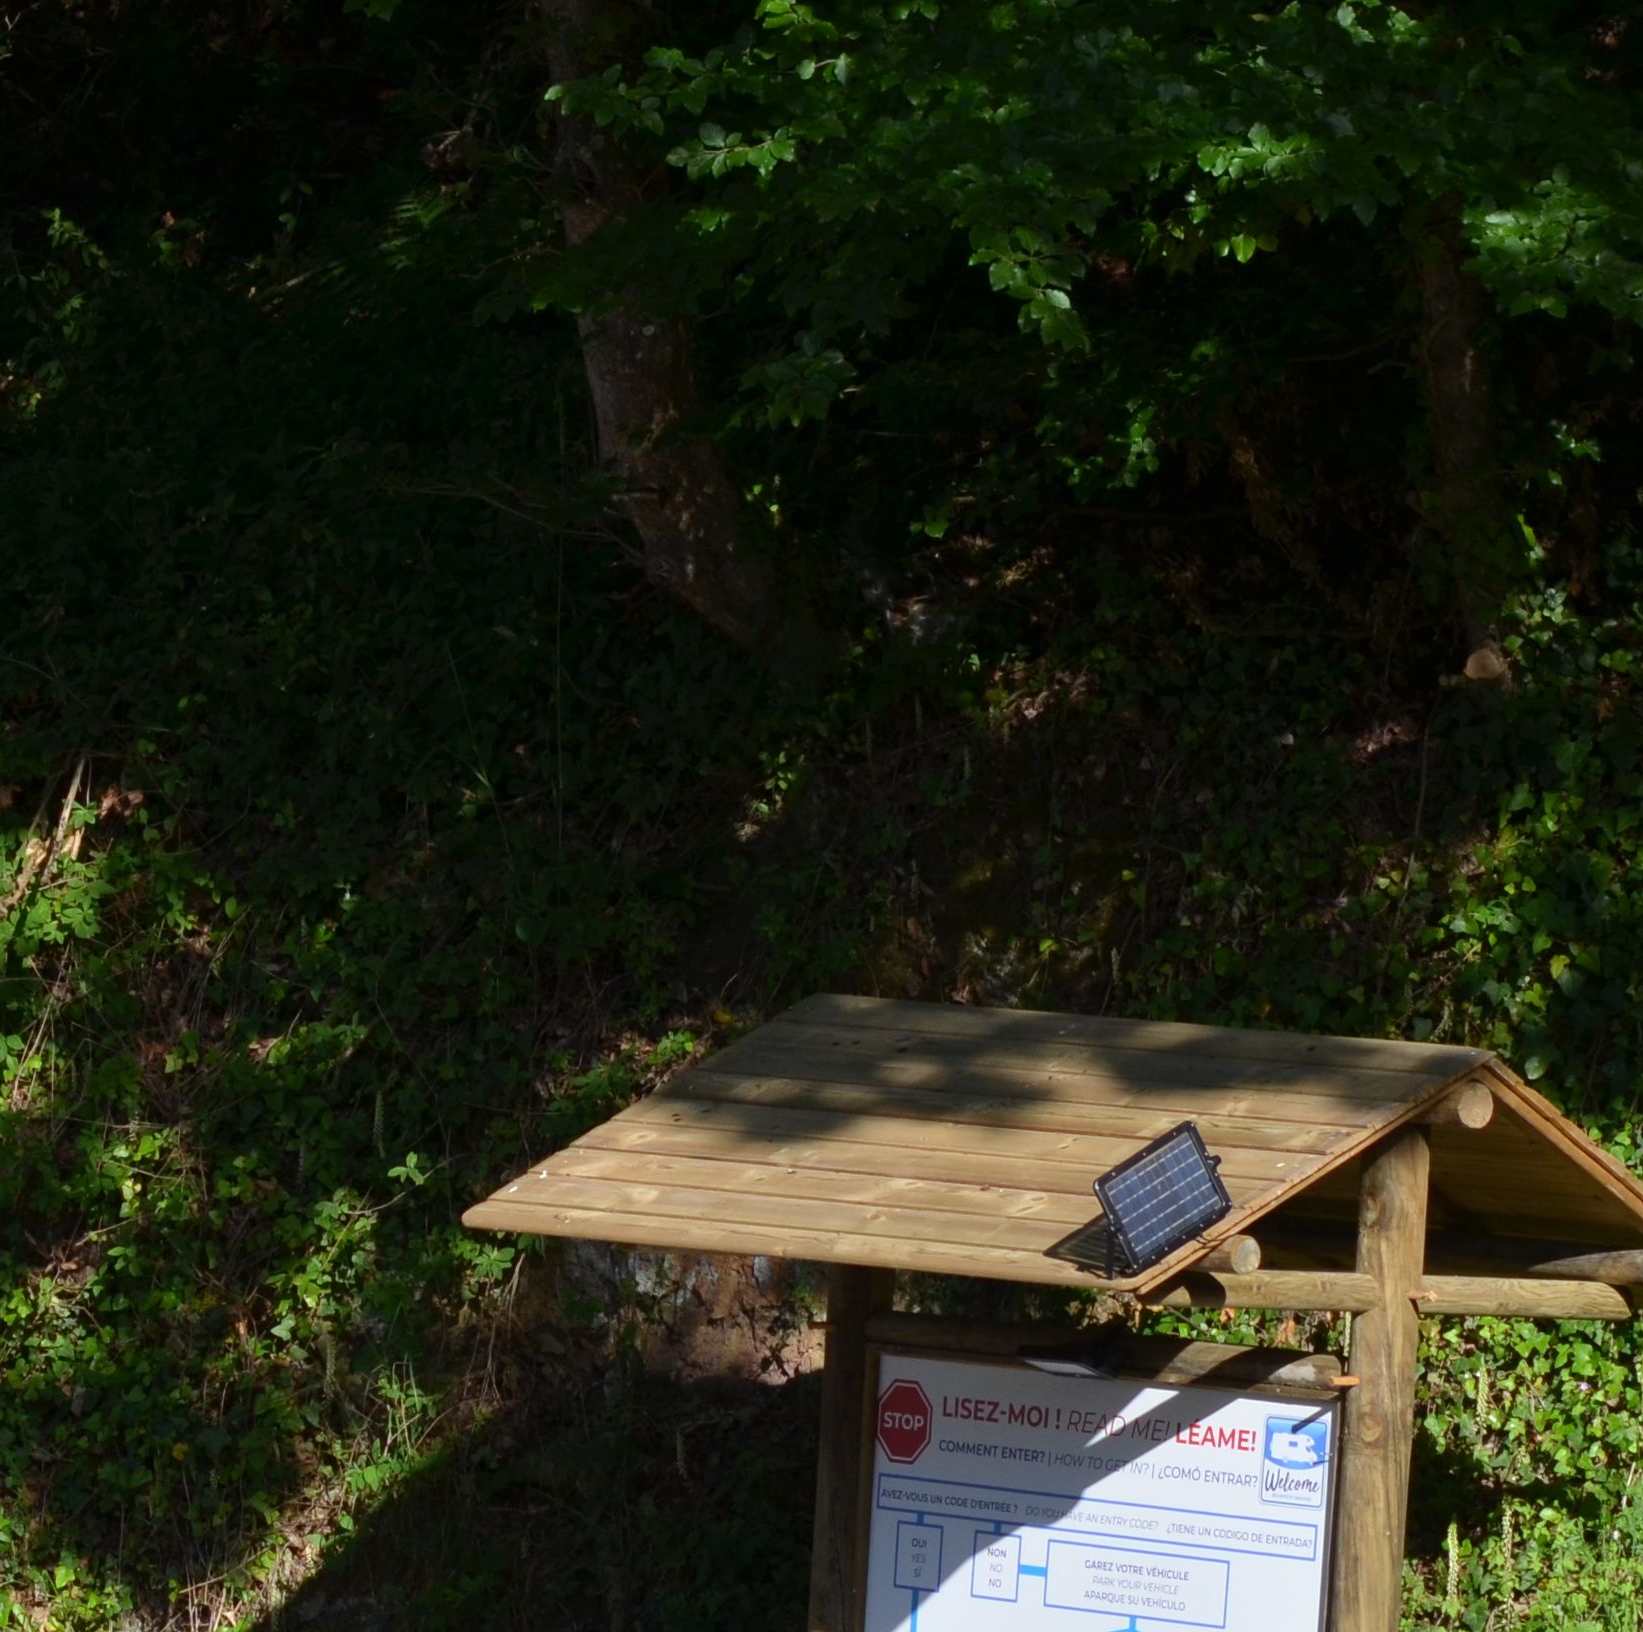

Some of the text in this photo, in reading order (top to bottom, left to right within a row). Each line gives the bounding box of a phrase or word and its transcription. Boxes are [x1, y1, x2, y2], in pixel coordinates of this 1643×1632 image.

[884, 1412, 924, 1431] STOP
[943, 1396, 1256, 1451] LISEZ-MOI READ ME! LÉAME!
[939, 1440, 999, 1458] COMMENT
[1001, 1447, 1045, 1463] ENTER?
[1054, 1456, 1083, 1468] HOW
[1088, 1457, 1102, 1469] TO
[1105, 1460, 1126, 1472] GET
[1130, 1462, 1149, 1473] IN?
[1204, 1470, 1257, 1488] ENTRAR?
[1265, 1469, 1320, 1493] Welcome
[882, 1488, 928, 1502] AVEZ-VOUS
[930, 1494, 942, 1504] UN
[945, 1496, 967, 1508] CODE
[970, 1500, 1011, 1513] D'ENTRÉE
[1026, 1506, 1039, 1515] DO
[1042, 1508, 1060, 1517] YOU
[1060, 1509, 1083, 1522] HAVE
[1086, 1514, 1098, 1524] AN
[1100, 1516, 1128, 1528] ENTRY
[1129, 1519, 1158, 1531] CODE?
[1167, 1524, 1195, 1535] ¿TIENE
[1198, 1527, 1210, 1536] UN
[1251, 1533, 1263, 1543] DE
[1266, 1535, 1312, 1548] ENTRADA?
[912, 1538, 927, 1549] OUI
[987, 1548, 1006, 1558] NON
[912, 1553, 925, 1563] YES
[990, 1564, 1003, 1572] NO
[1085, 1560, 1189, 1581] GAREZ VOTRE VÉHICULE
[989, 1579, 1001, 1588] NO
[1092, 1576, 1179, 1595] PARK YOUR VEHICLE
[1084, 1591, 1185, 1611] APARQUE SU VEHÍCULO
